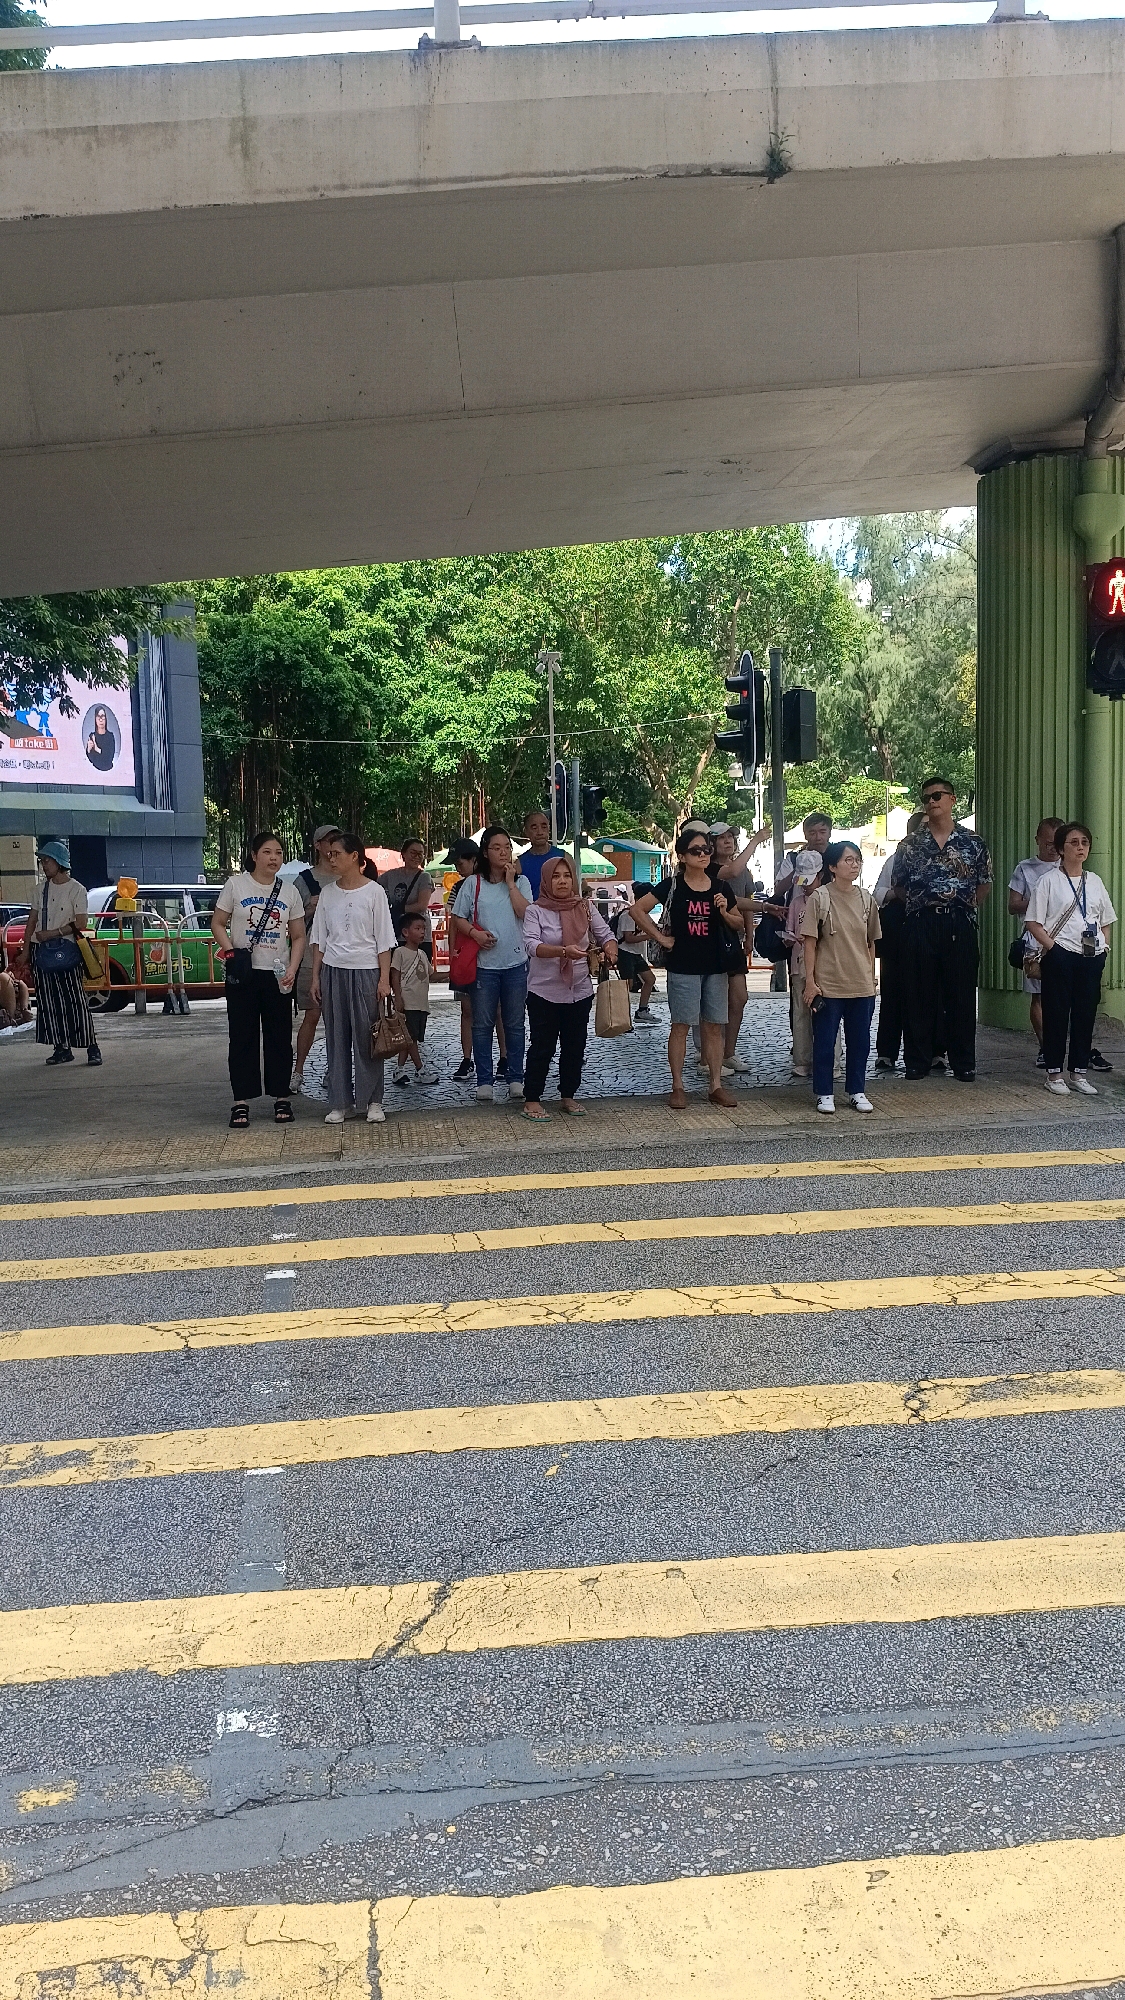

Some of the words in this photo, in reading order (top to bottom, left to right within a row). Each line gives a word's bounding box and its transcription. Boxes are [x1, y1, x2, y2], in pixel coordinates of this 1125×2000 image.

[240, 896, 265, 908] HELLO
[265, 897, 288, 911] TTY
[687, 900, 711, 915] ME
[687, 921, 709, 936] WE
